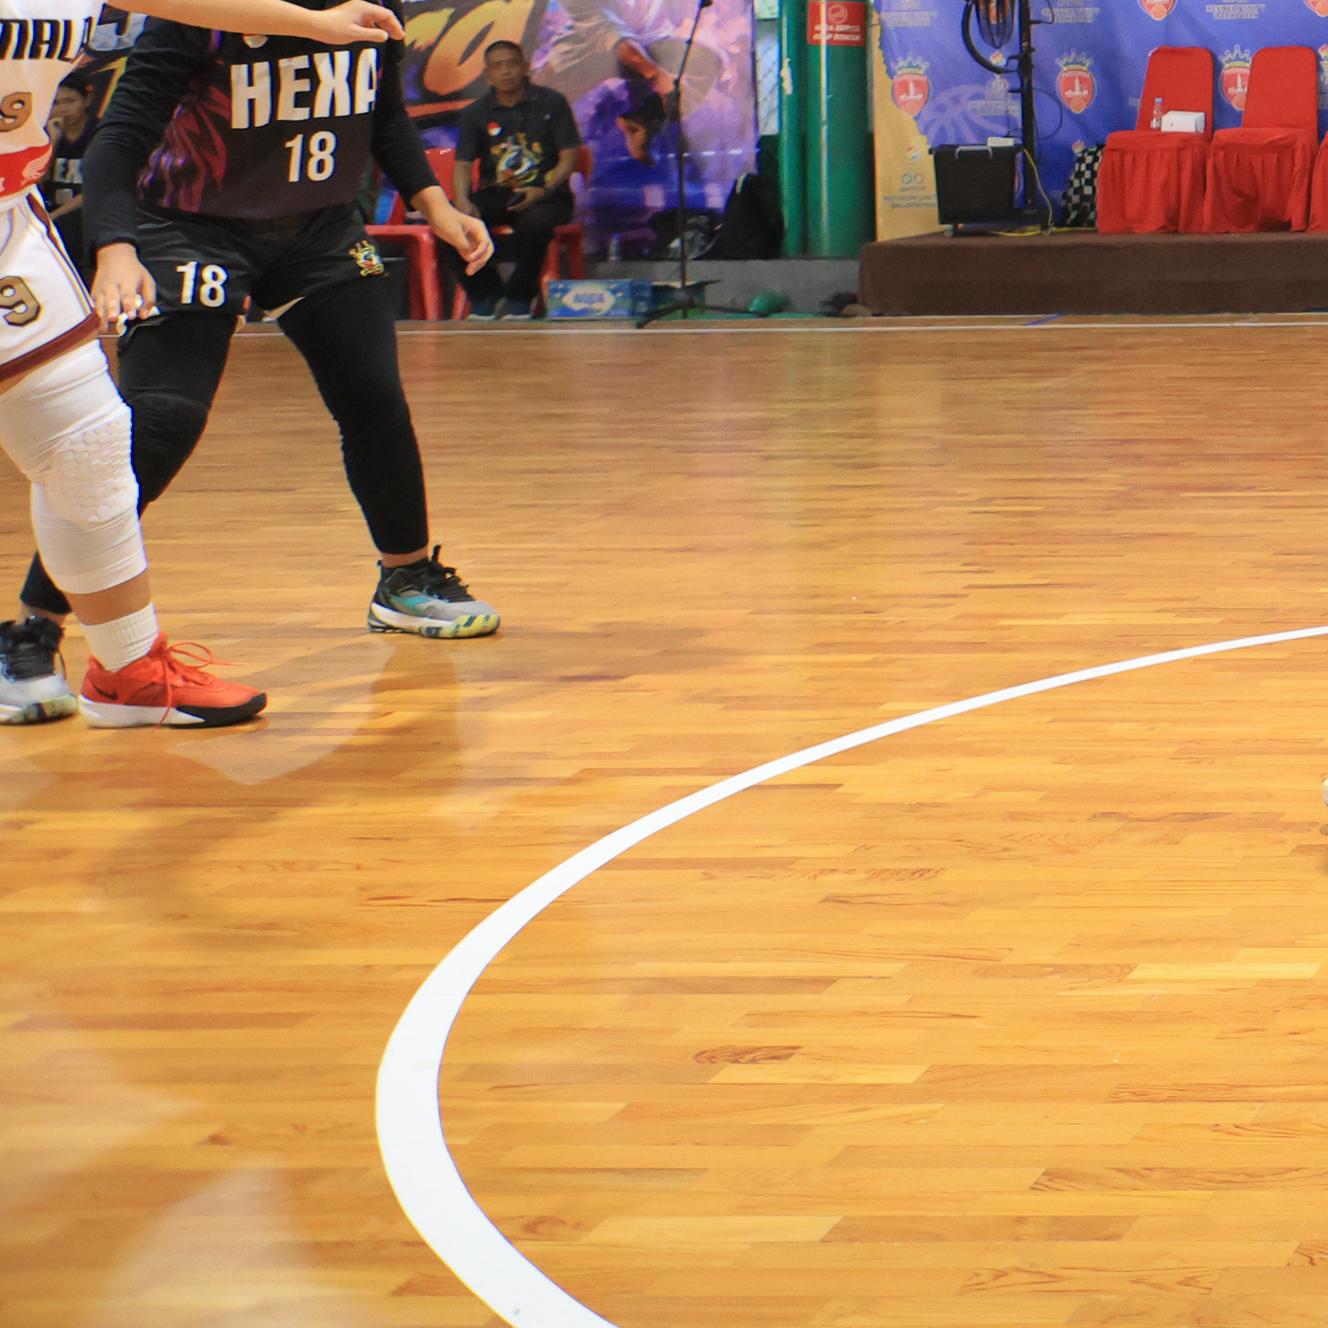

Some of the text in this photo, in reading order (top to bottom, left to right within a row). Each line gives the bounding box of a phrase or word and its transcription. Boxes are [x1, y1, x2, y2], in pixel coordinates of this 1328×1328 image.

[230, 47, 378, 129] HEXA
[284, 131, 337, 183] 18
[176, 260, 228, 308] 18
